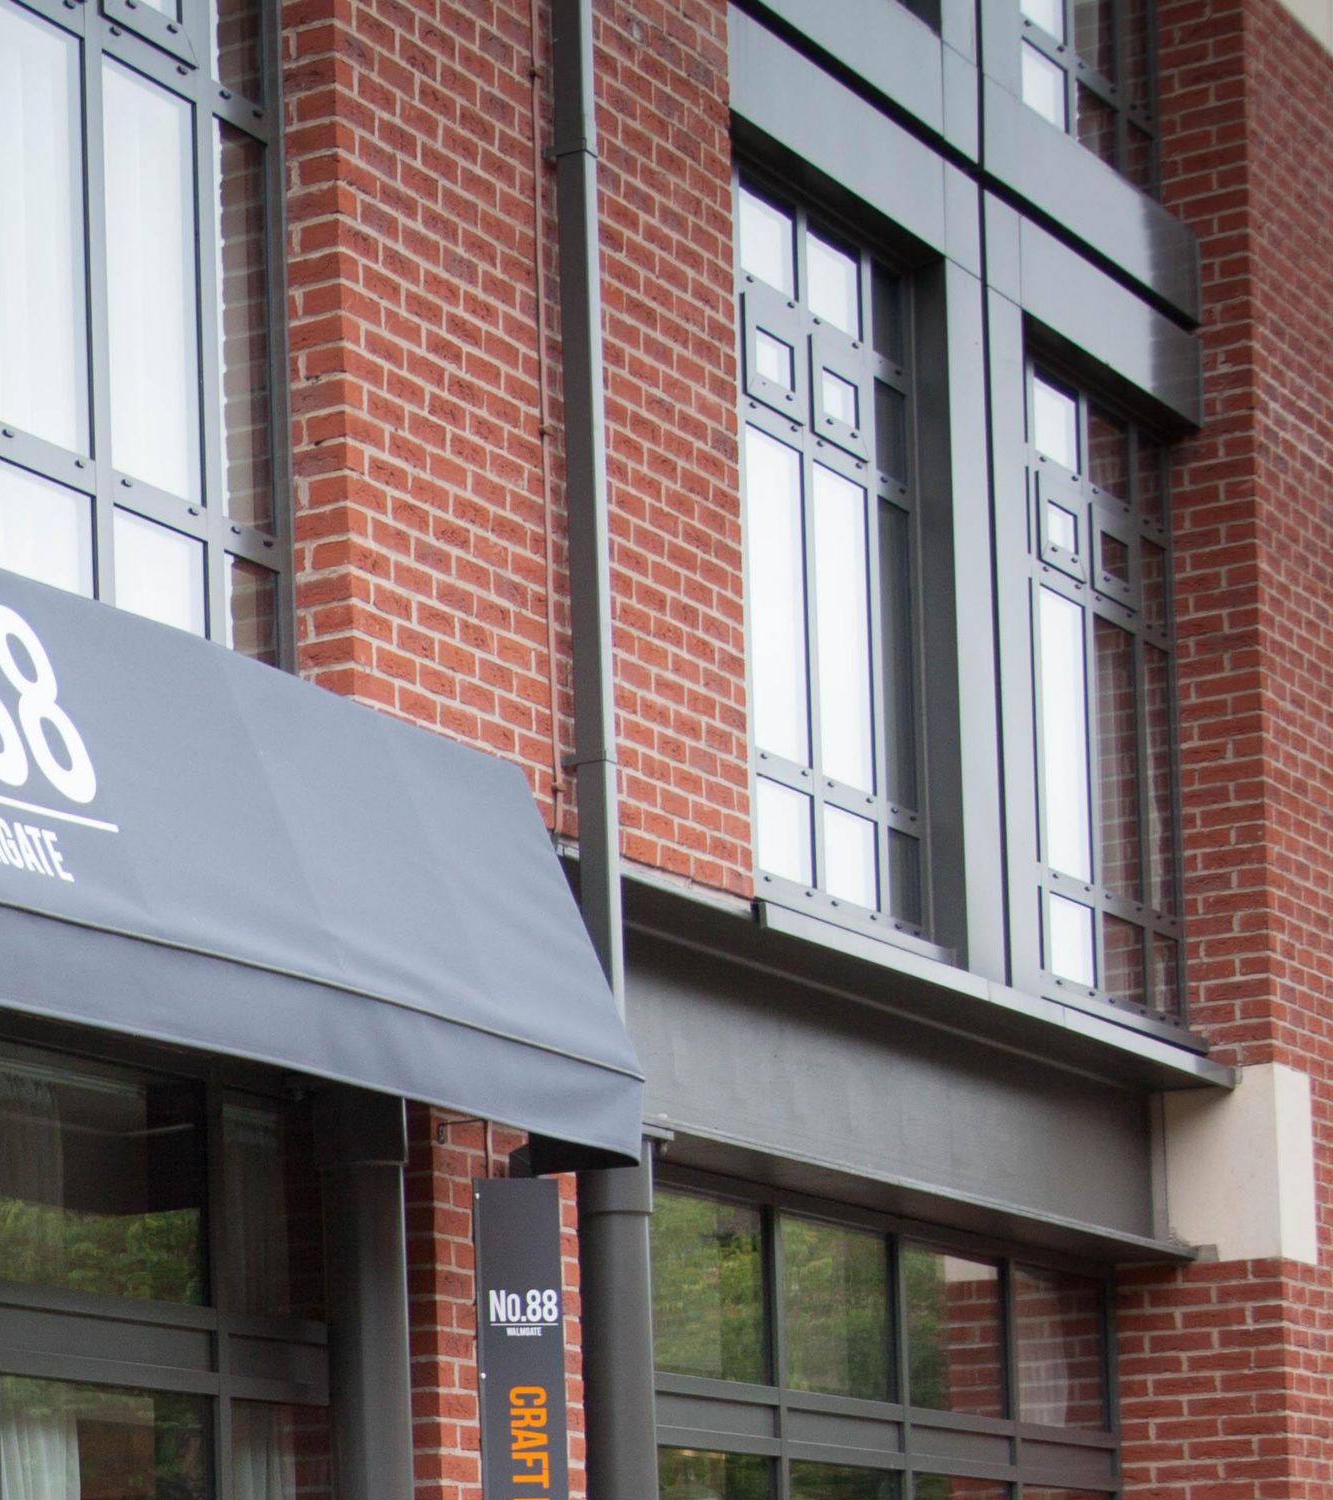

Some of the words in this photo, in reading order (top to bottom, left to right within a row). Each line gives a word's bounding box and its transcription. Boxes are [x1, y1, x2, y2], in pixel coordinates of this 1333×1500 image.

[489, 1289, 558, 1322] No.88
[506, 1327, 542, 1337] WALMGATE
[509, 1386, 550, 1489] CRAFT
